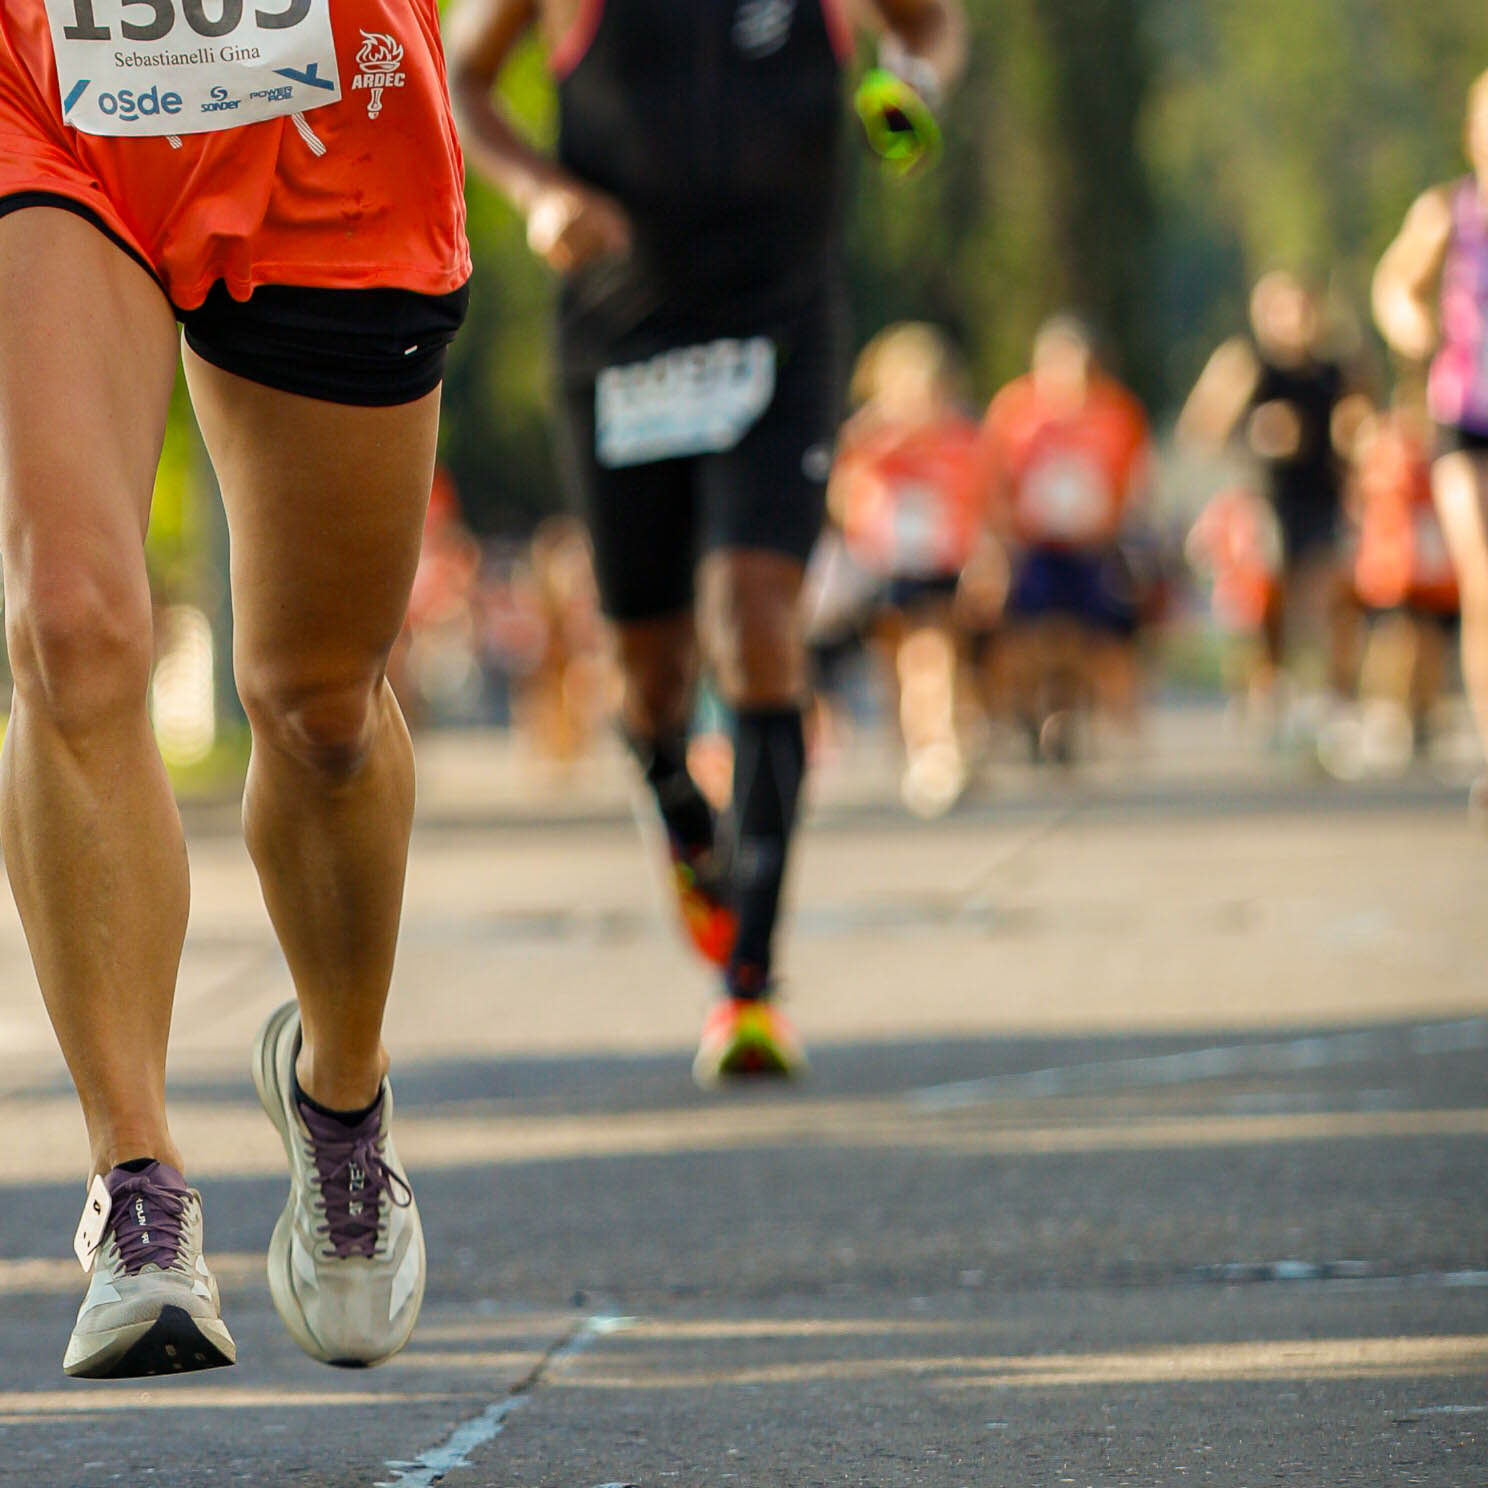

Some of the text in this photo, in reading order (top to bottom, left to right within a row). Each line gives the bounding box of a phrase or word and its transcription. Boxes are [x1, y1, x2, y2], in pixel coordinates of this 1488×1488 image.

[114, 45, 261, 68] Sebastianelli Gina
[352, 72, 407, 90] ARDEC
[98, 85, 183, 116] osde
